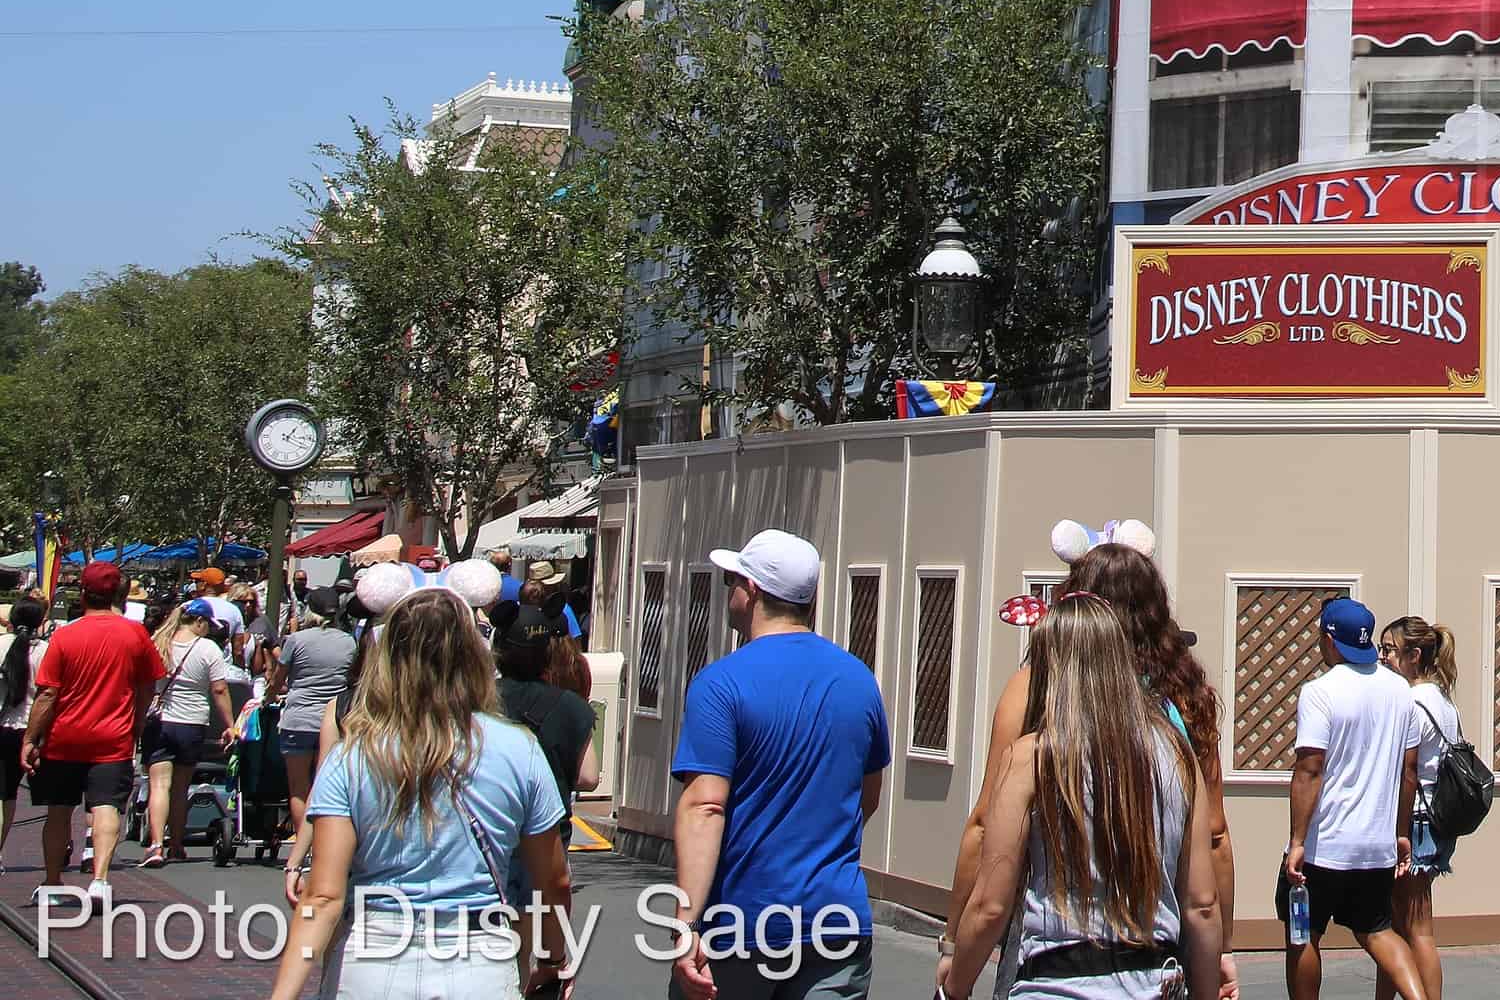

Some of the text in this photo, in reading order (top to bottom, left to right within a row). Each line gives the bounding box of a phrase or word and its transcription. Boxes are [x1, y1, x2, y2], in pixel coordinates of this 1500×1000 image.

[1149, 273, 1468, 345] DISNEY CLOTHIERS
[1289, 326, 1326, 342] LTD.
